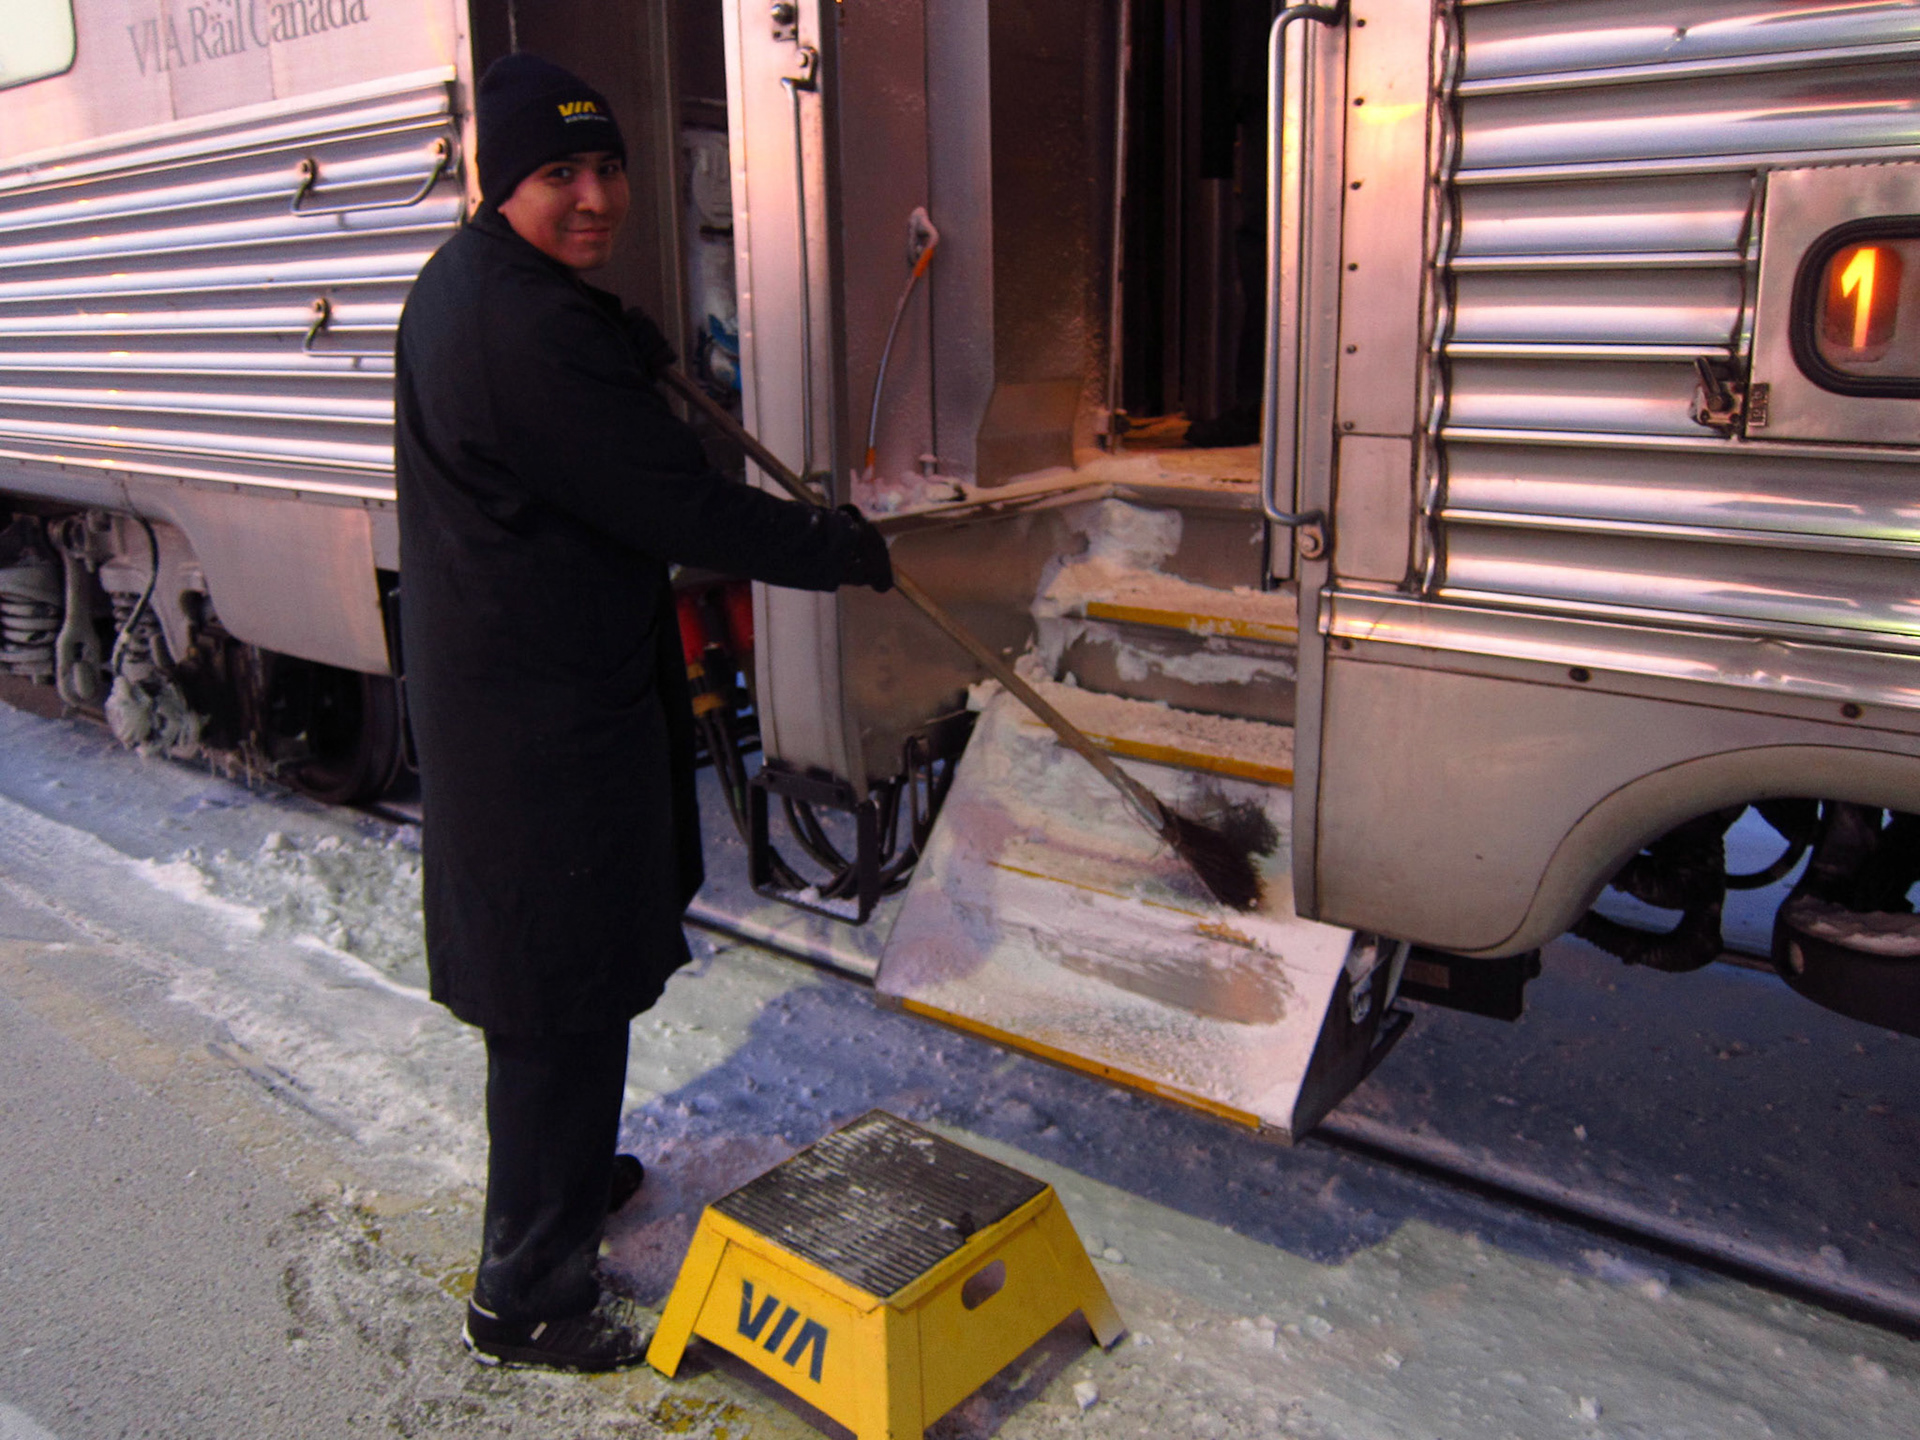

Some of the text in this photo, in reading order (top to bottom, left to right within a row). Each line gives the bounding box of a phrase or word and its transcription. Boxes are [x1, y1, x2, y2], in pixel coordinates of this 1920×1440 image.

[127, 15, 186, 76] VIA
[558, 101, 597, 117] VIA
[1840, 246, 1878, 351] 1
[737, 1278, 829, 1384] VIA
